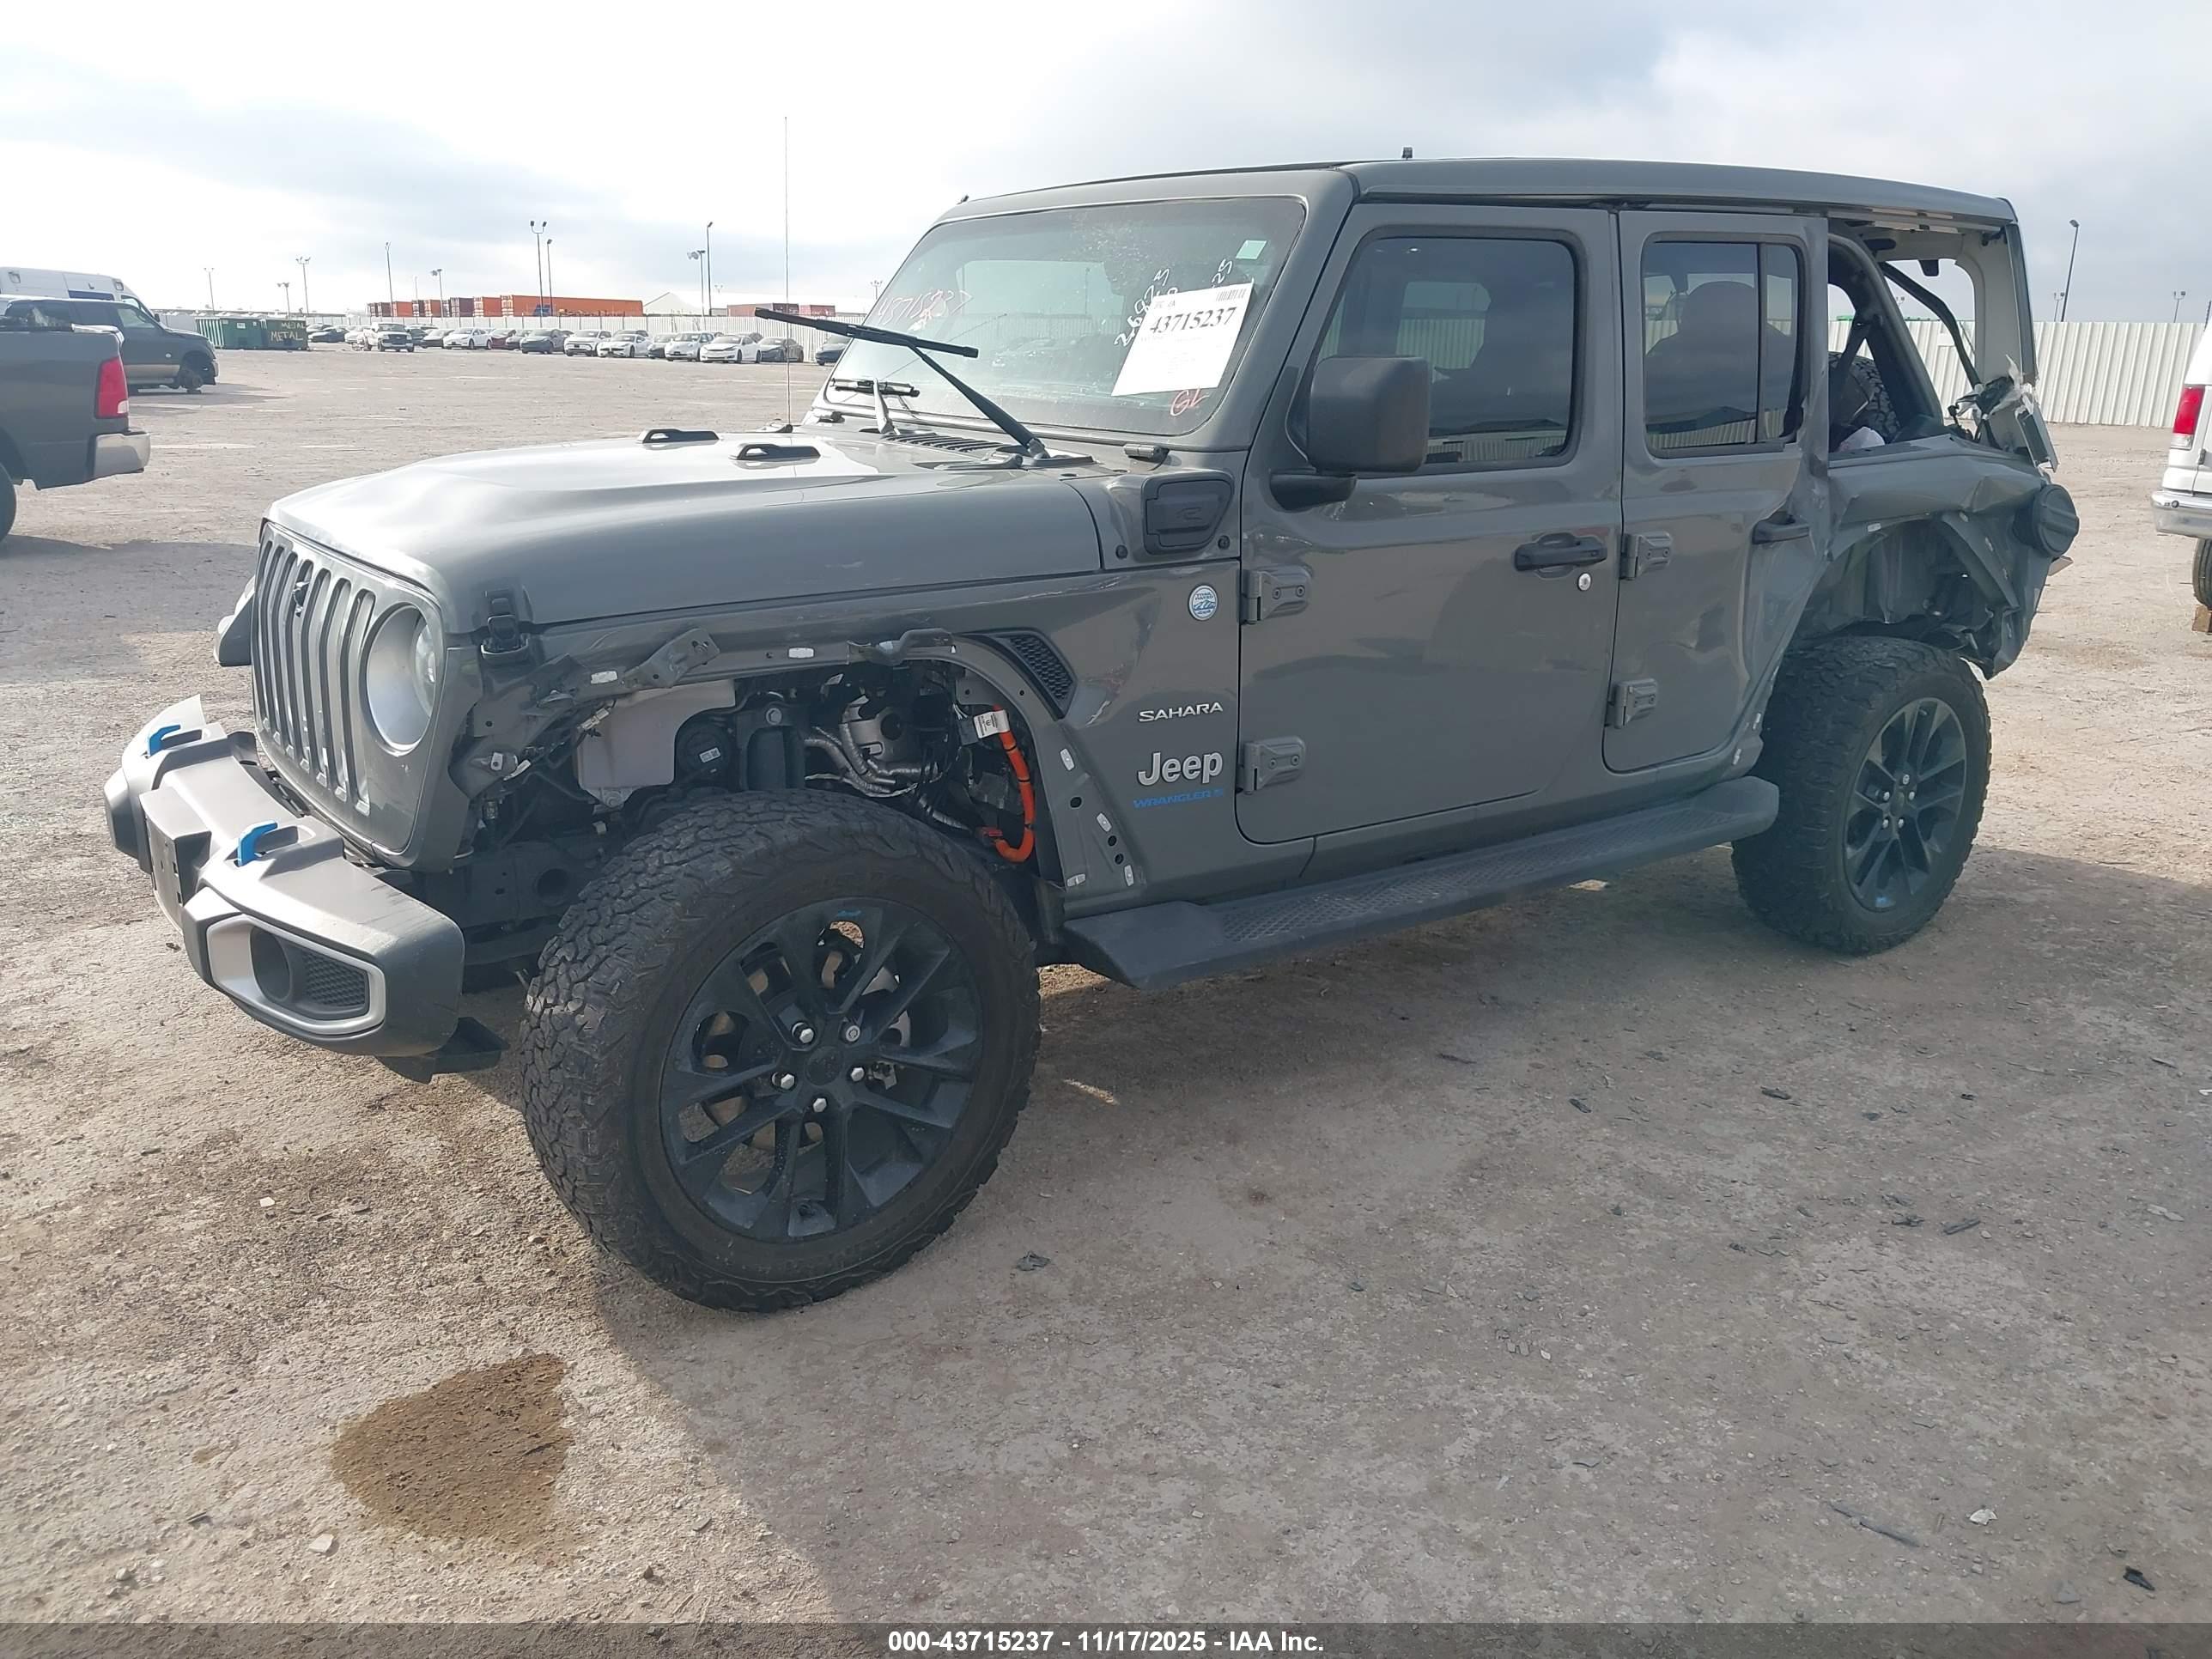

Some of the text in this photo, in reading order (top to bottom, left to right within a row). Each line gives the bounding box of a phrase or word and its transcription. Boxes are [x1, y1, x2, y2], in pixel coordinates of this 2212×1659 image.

[1149, 307, 1237, 334] 43715237
[270, 331, 303, 342] METAL
[1139, 702, 1224, 722] SAHARA
[1138, 752, 1223, 786] Jeep
[1133, 790, 1210, 808] WRANGLER
